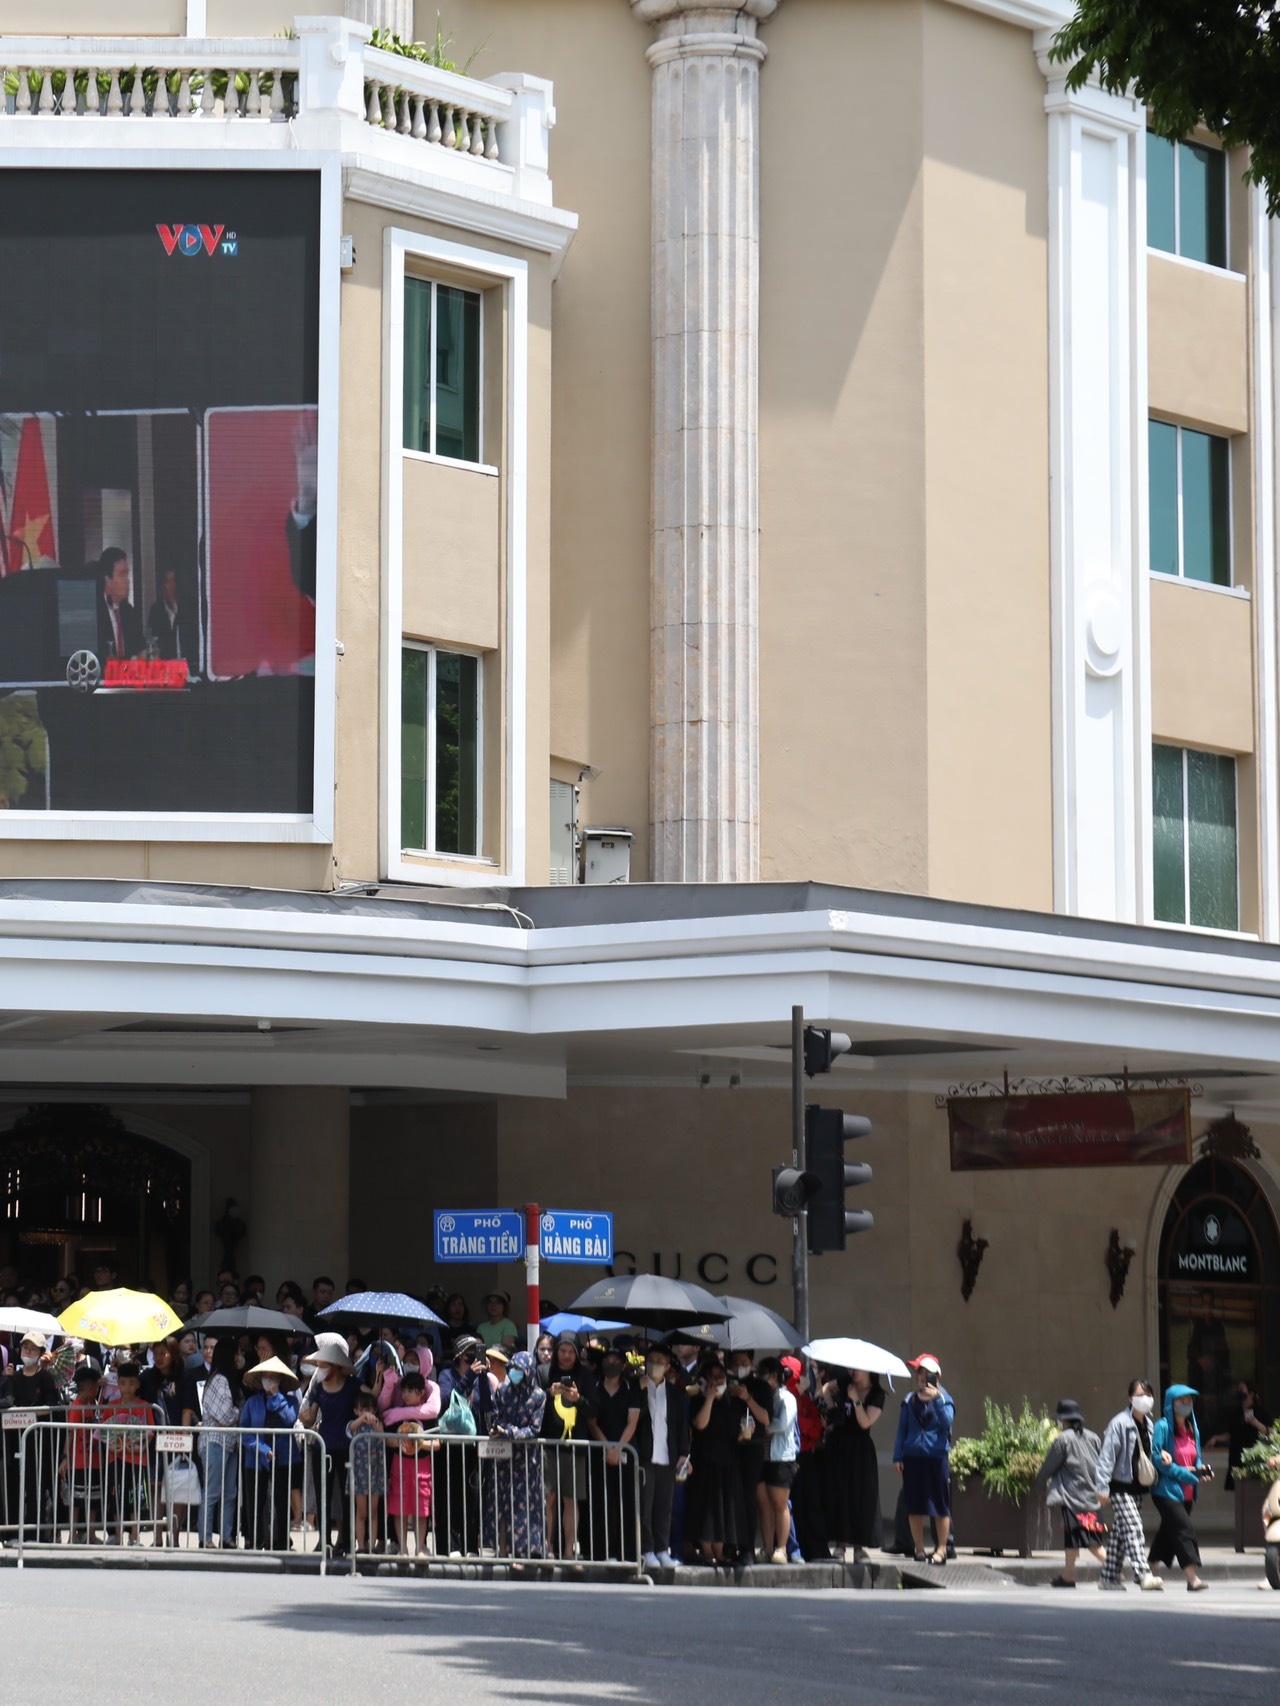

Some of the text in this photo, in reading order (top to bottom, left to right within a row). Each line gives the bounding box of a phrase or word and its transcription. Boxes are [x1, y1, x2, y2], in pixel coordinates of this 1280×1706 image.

[222, 243, 236, 254] TV
[474, 1215, 501, 1228] PHỐ
[570, 1217, 593, 1230] PHỐ
[442, 1231, 518, 1254] TRÀNG TIỀN
[544, 1232, 607, 1257] HÀNG BÀI
[605, 1251, 797, 1285] GUCC
[1178, 1253, 1247, 1273] MONTBLANC
